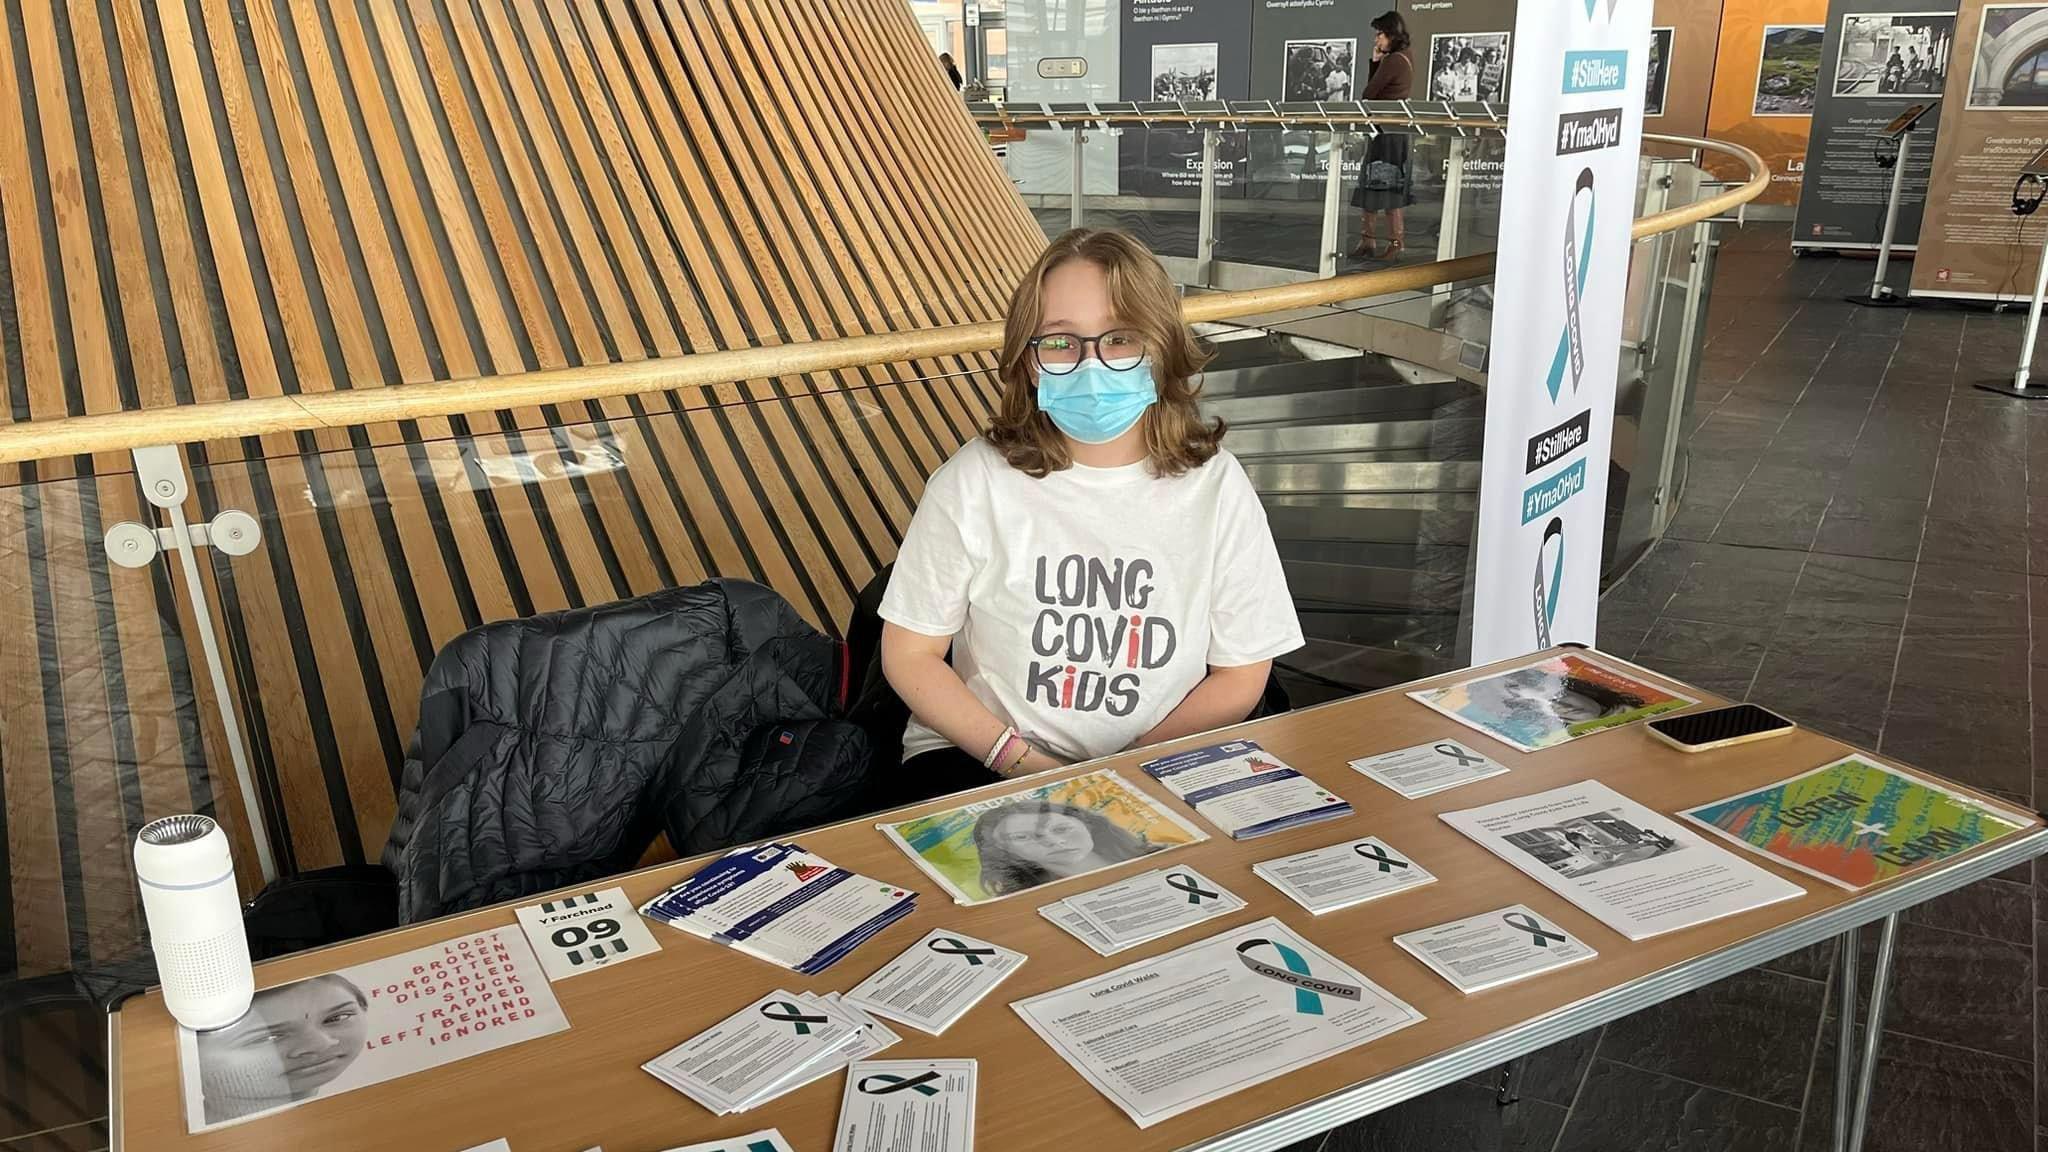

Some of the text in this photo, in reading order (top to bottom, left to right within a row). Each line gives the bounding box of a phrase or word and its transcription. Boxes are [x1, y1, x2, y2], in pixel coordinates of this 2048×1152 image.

[1571, 59, 1619, 88] #StillHere
[1560, 114, 1618, 150] #YmaOHyd
[1186, 158, 1233, 172] Expsion
[1565, 241, 1576, 306] LONG
[1535, 424, 1583, 465] #StillHere
[1526, 466, 1582, 518] #YmaOHyd
[1034, 553, 1155, 611] LONG
[550, 903, 614, 922] Farchnad
[444, 932, 500, 955] LOST
[551, 918, 622, 948] 09
[371, 952, 511, 998] FORGOTTEN
[412, 942, 506, 976] BROKEN
[442, 974, 521, 1003] STUCK
[1090, 972, 1161, 998] Long Covid Wales
[1254, 965, 1355, 996] LONG COVID
[416, 985, 526, 1024] TRAPPED
[366, 996, 530, 1051] LEFT BEHIND
[429, 1008, 537, 1046] IGNORED
